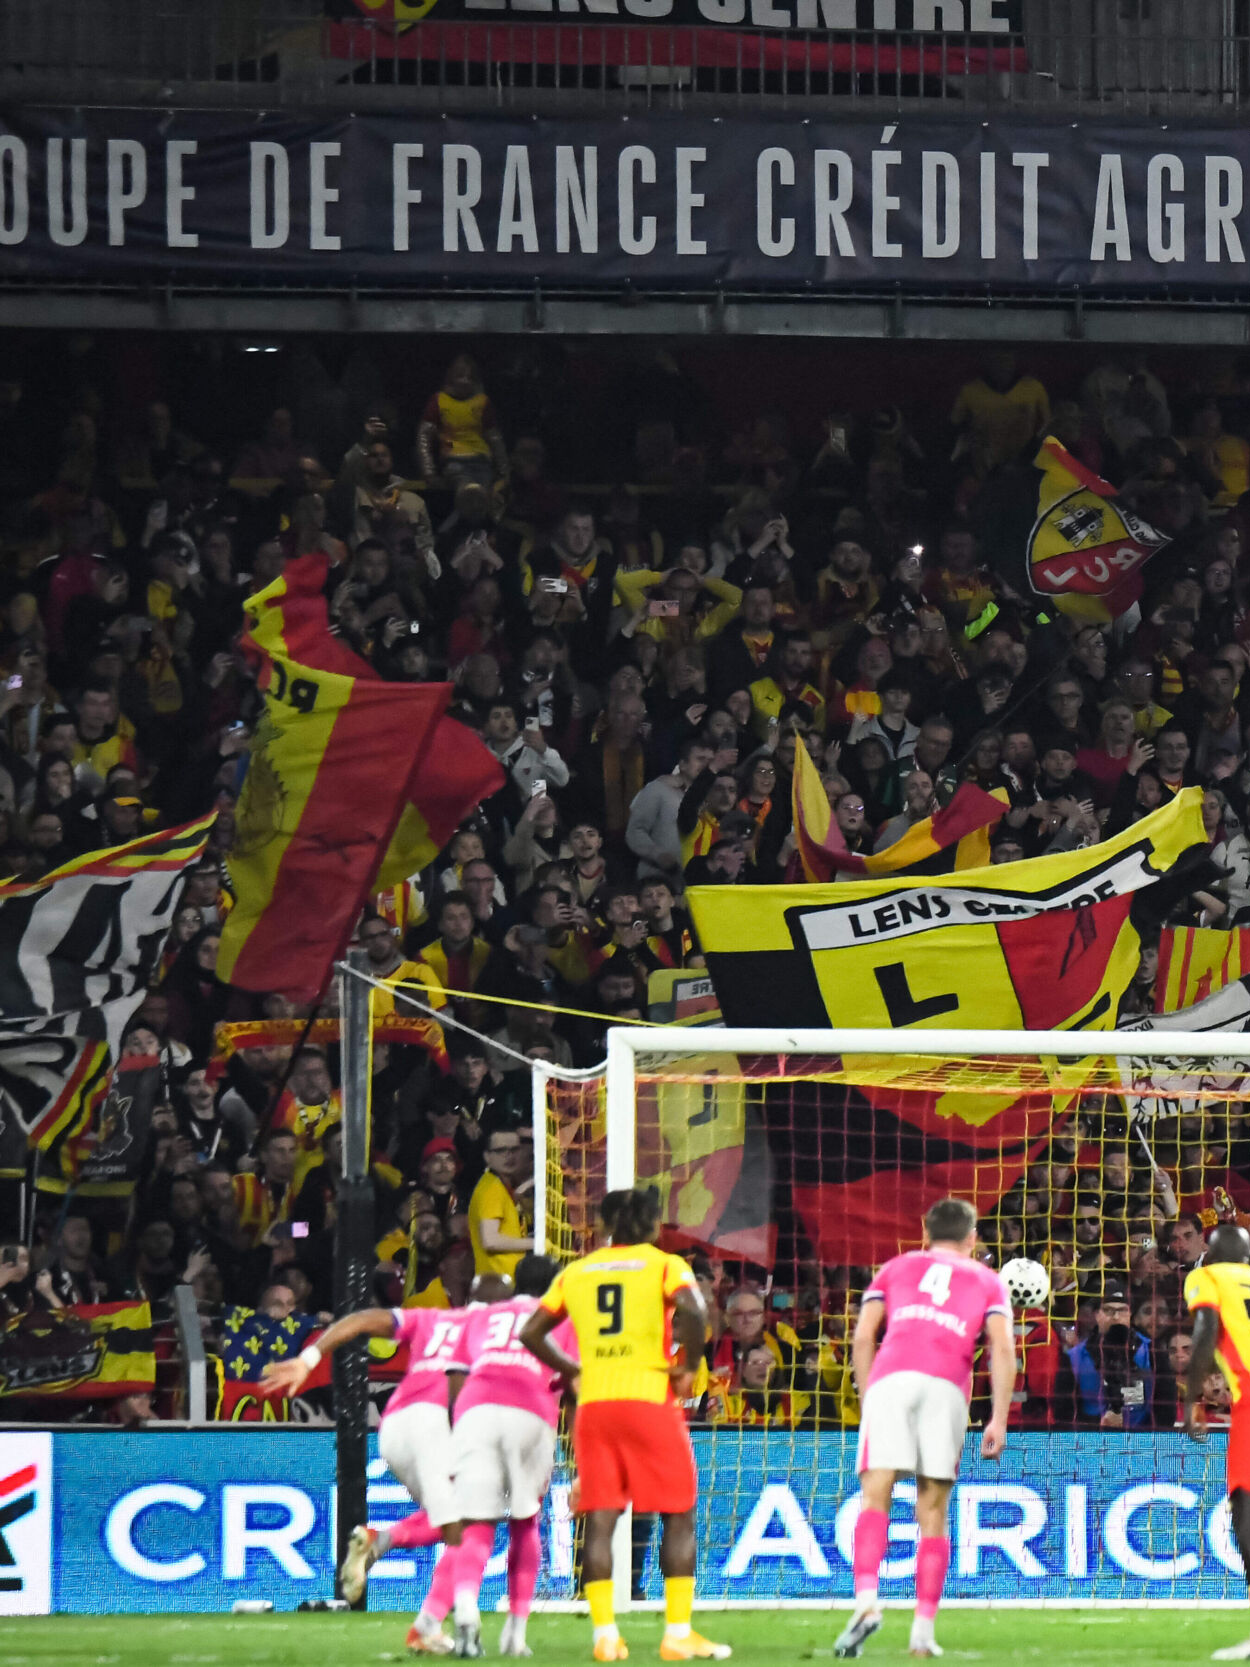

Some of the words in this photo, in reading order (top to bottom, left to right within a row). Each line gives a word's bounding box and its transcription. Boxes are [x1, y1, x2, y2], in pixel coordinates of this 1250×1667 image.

[0, 136, 198, 248] OUPE
[250, 142, 341, 250] DE
[393, 143, 707, 256] FRANCE
[757, 126, 1048, 259] CRÉDIT
[848, 894, 951, 938] LENS
[918, 1262, 954, 1307] 4
[597, 1283, 623, 1335] 9
